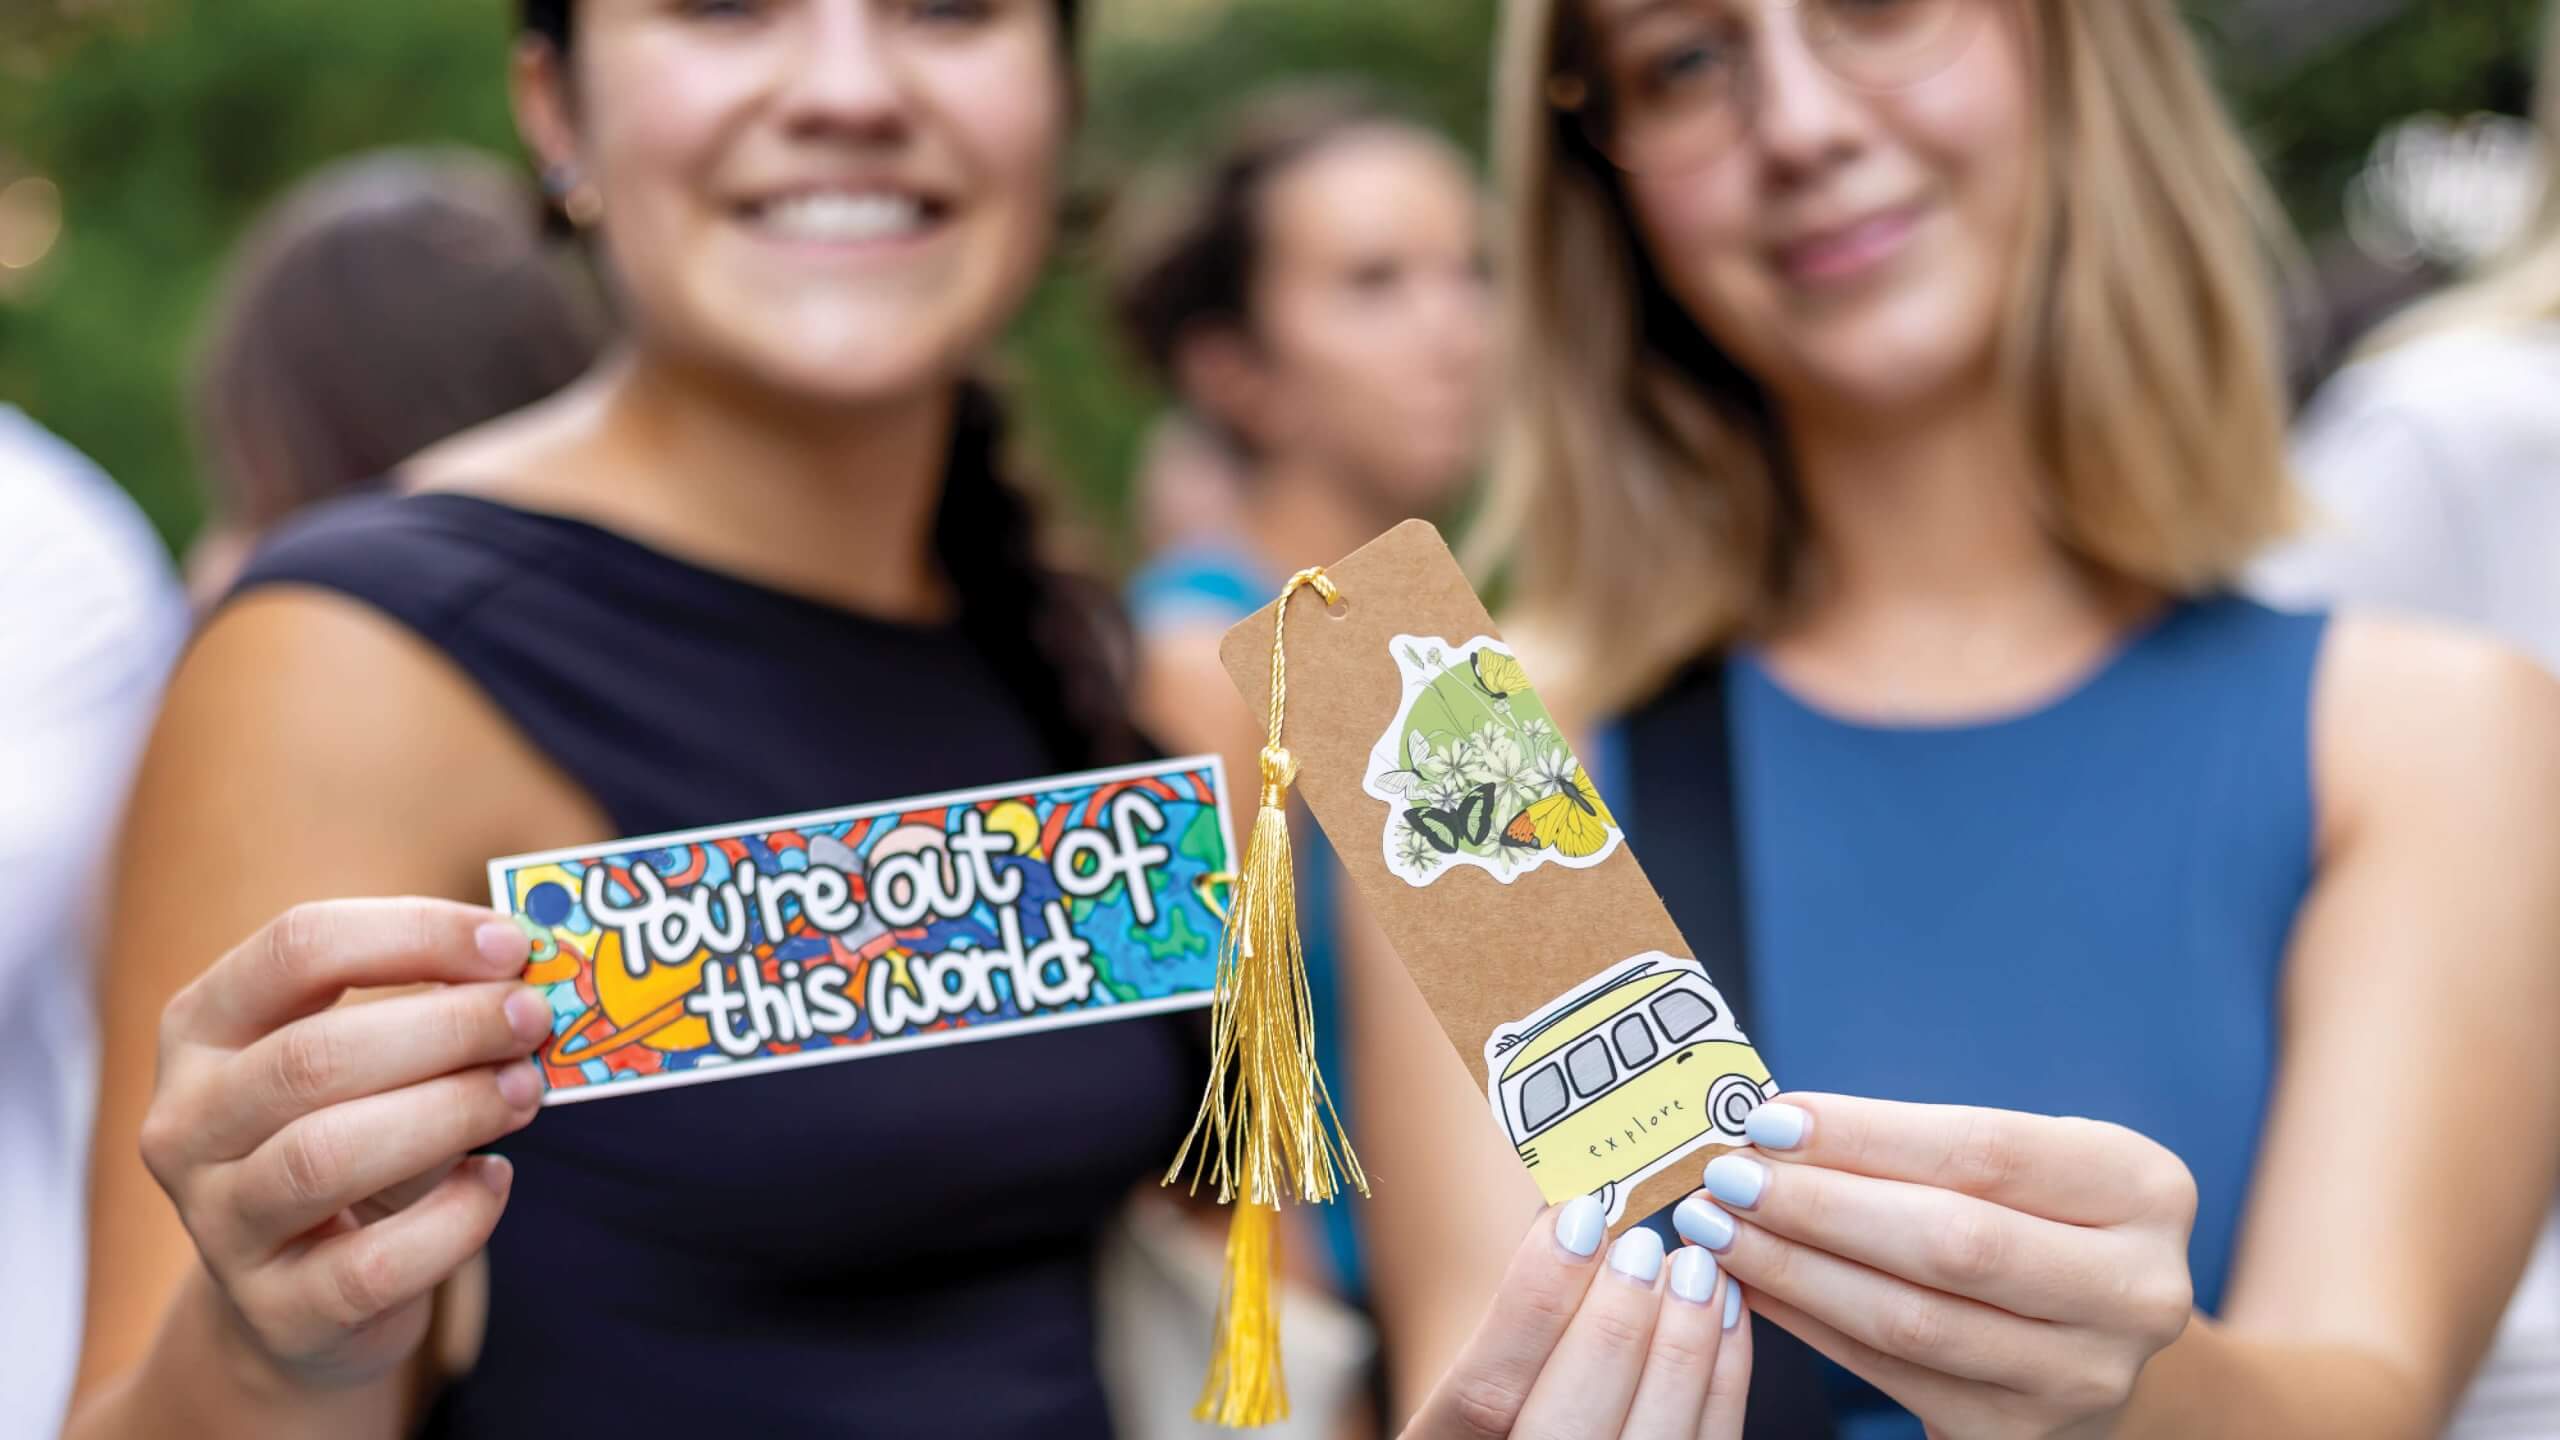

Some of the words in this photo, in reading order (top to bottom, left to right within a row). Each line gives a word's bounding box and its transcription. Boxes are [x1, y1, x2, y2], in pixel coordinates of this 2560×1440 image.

[584, 859, 859, 975] You're
[871, 810, 1022, 925] out
[1053, 791, 1167, 924] of
[689, 960, 858, 1056] this
[1589, 1100, 1684, 1157] explore
